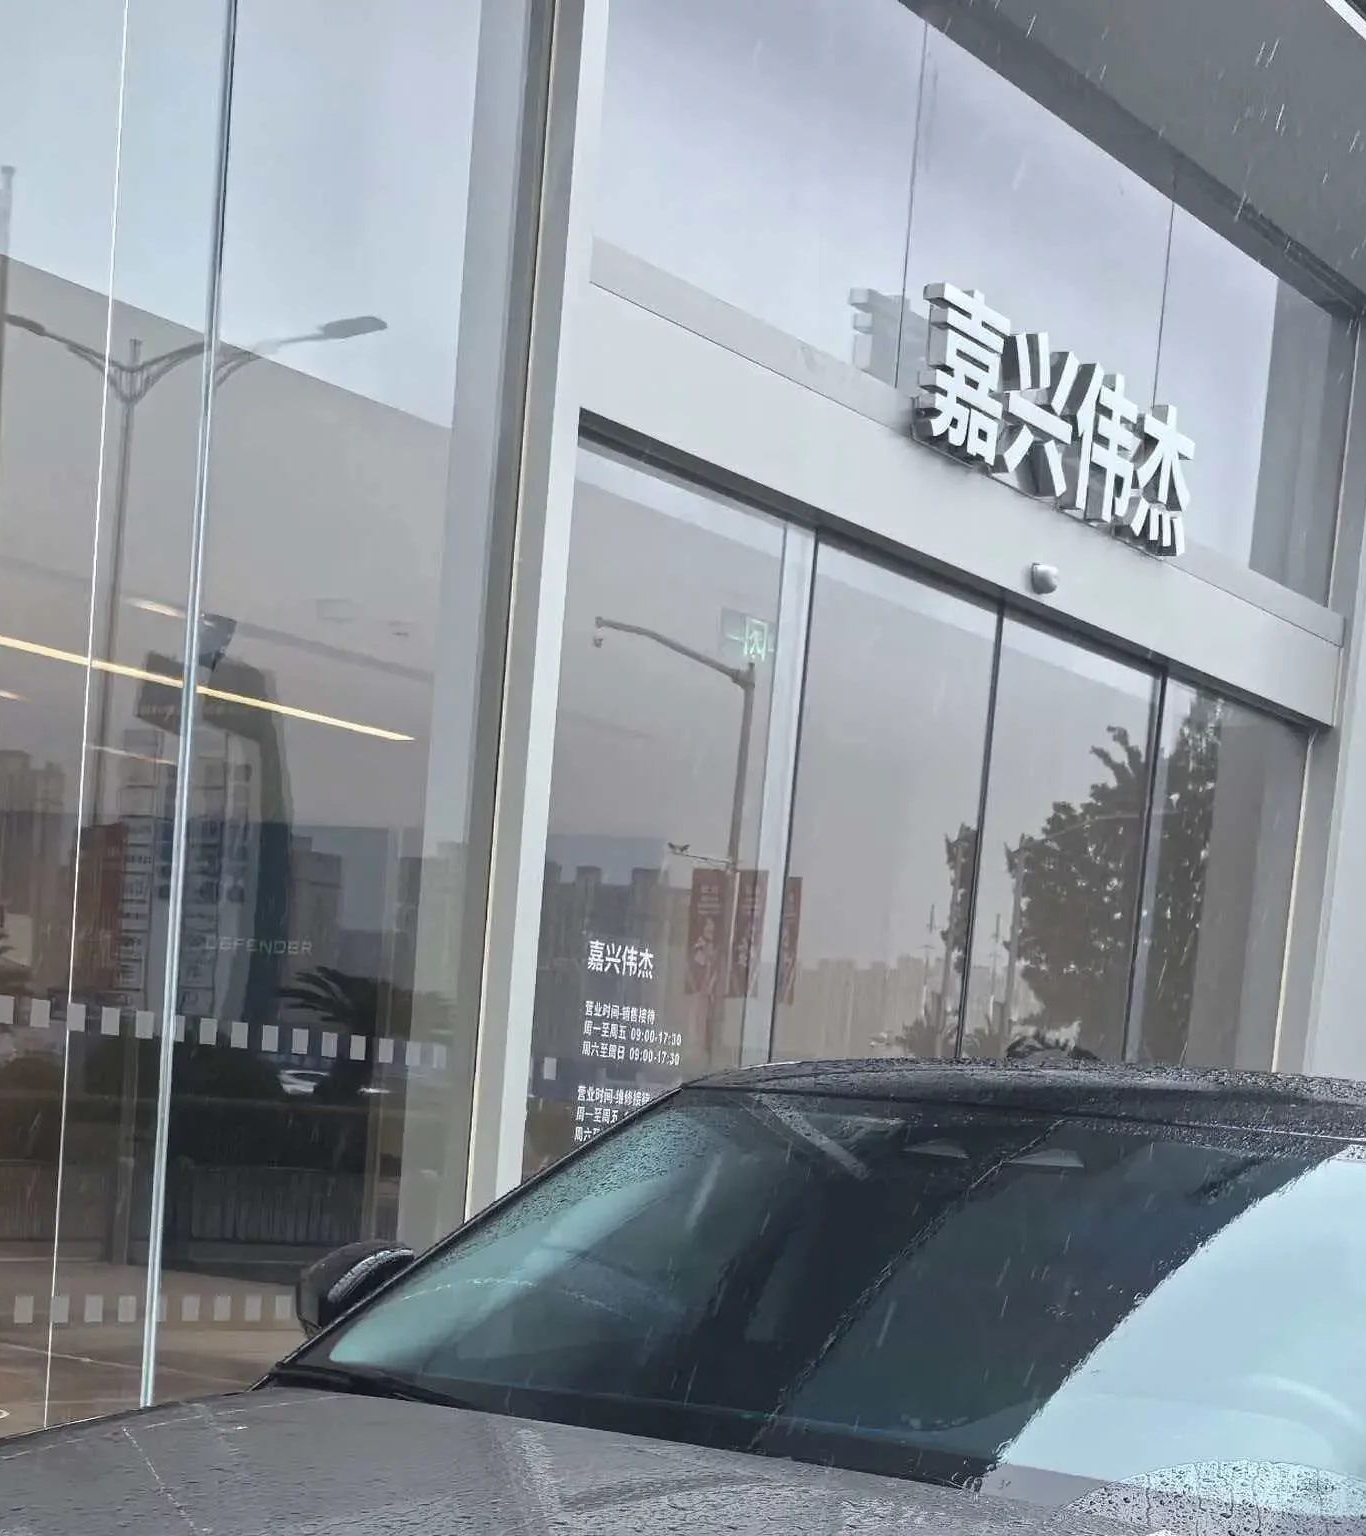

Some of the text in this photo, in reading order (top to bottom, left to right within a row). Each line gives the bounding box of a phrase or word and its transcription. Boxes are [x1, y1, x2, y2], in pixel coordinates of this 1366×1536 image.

[912, 282, 1195, 556] 嘉兴伟杰
[587, 940, 654, 979] 嘉兴伟杰
[585, 1001, 655, 1025] 营业时间-销售接待
[583, 1020, 682, 1047] 周一至周五 09:00-17:30
[582, 1041, 681, 1066] 周六至周日 09:00-17:30
